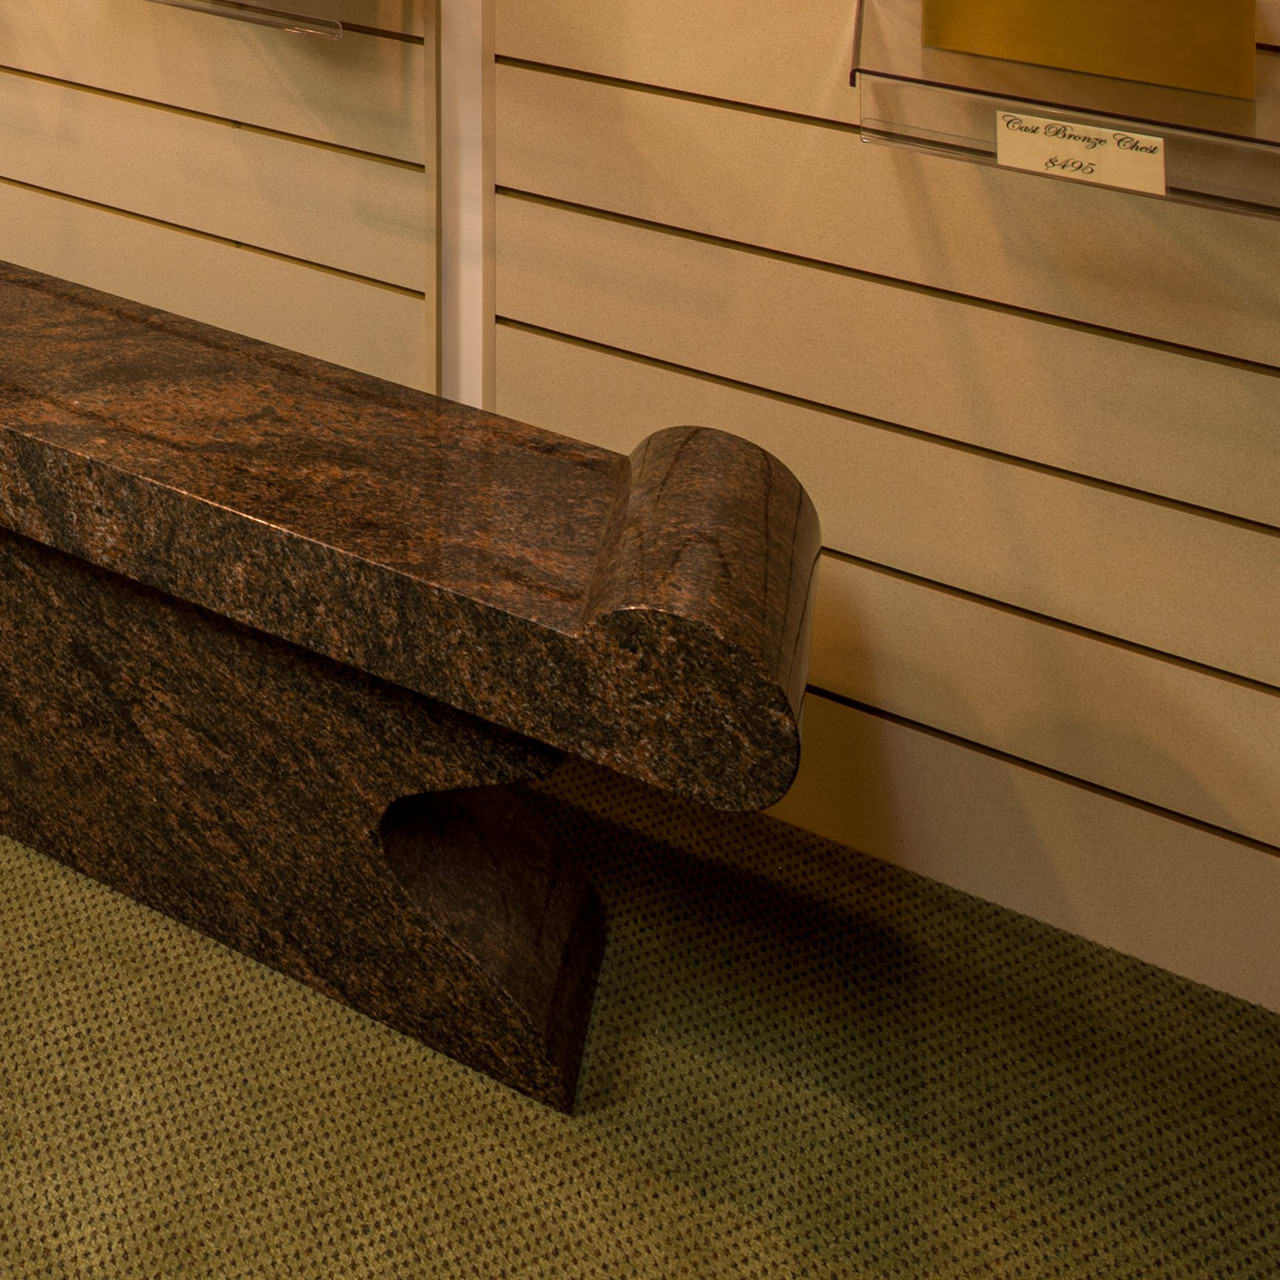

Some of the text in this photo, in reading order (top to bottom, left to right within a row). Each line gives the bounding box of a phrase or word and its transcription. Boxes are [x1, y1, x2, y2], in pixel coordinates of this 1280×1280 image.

[1002, 114, 1159, 155] Cast Bronze Chest
[1044, 155, 1097, 175] $495
